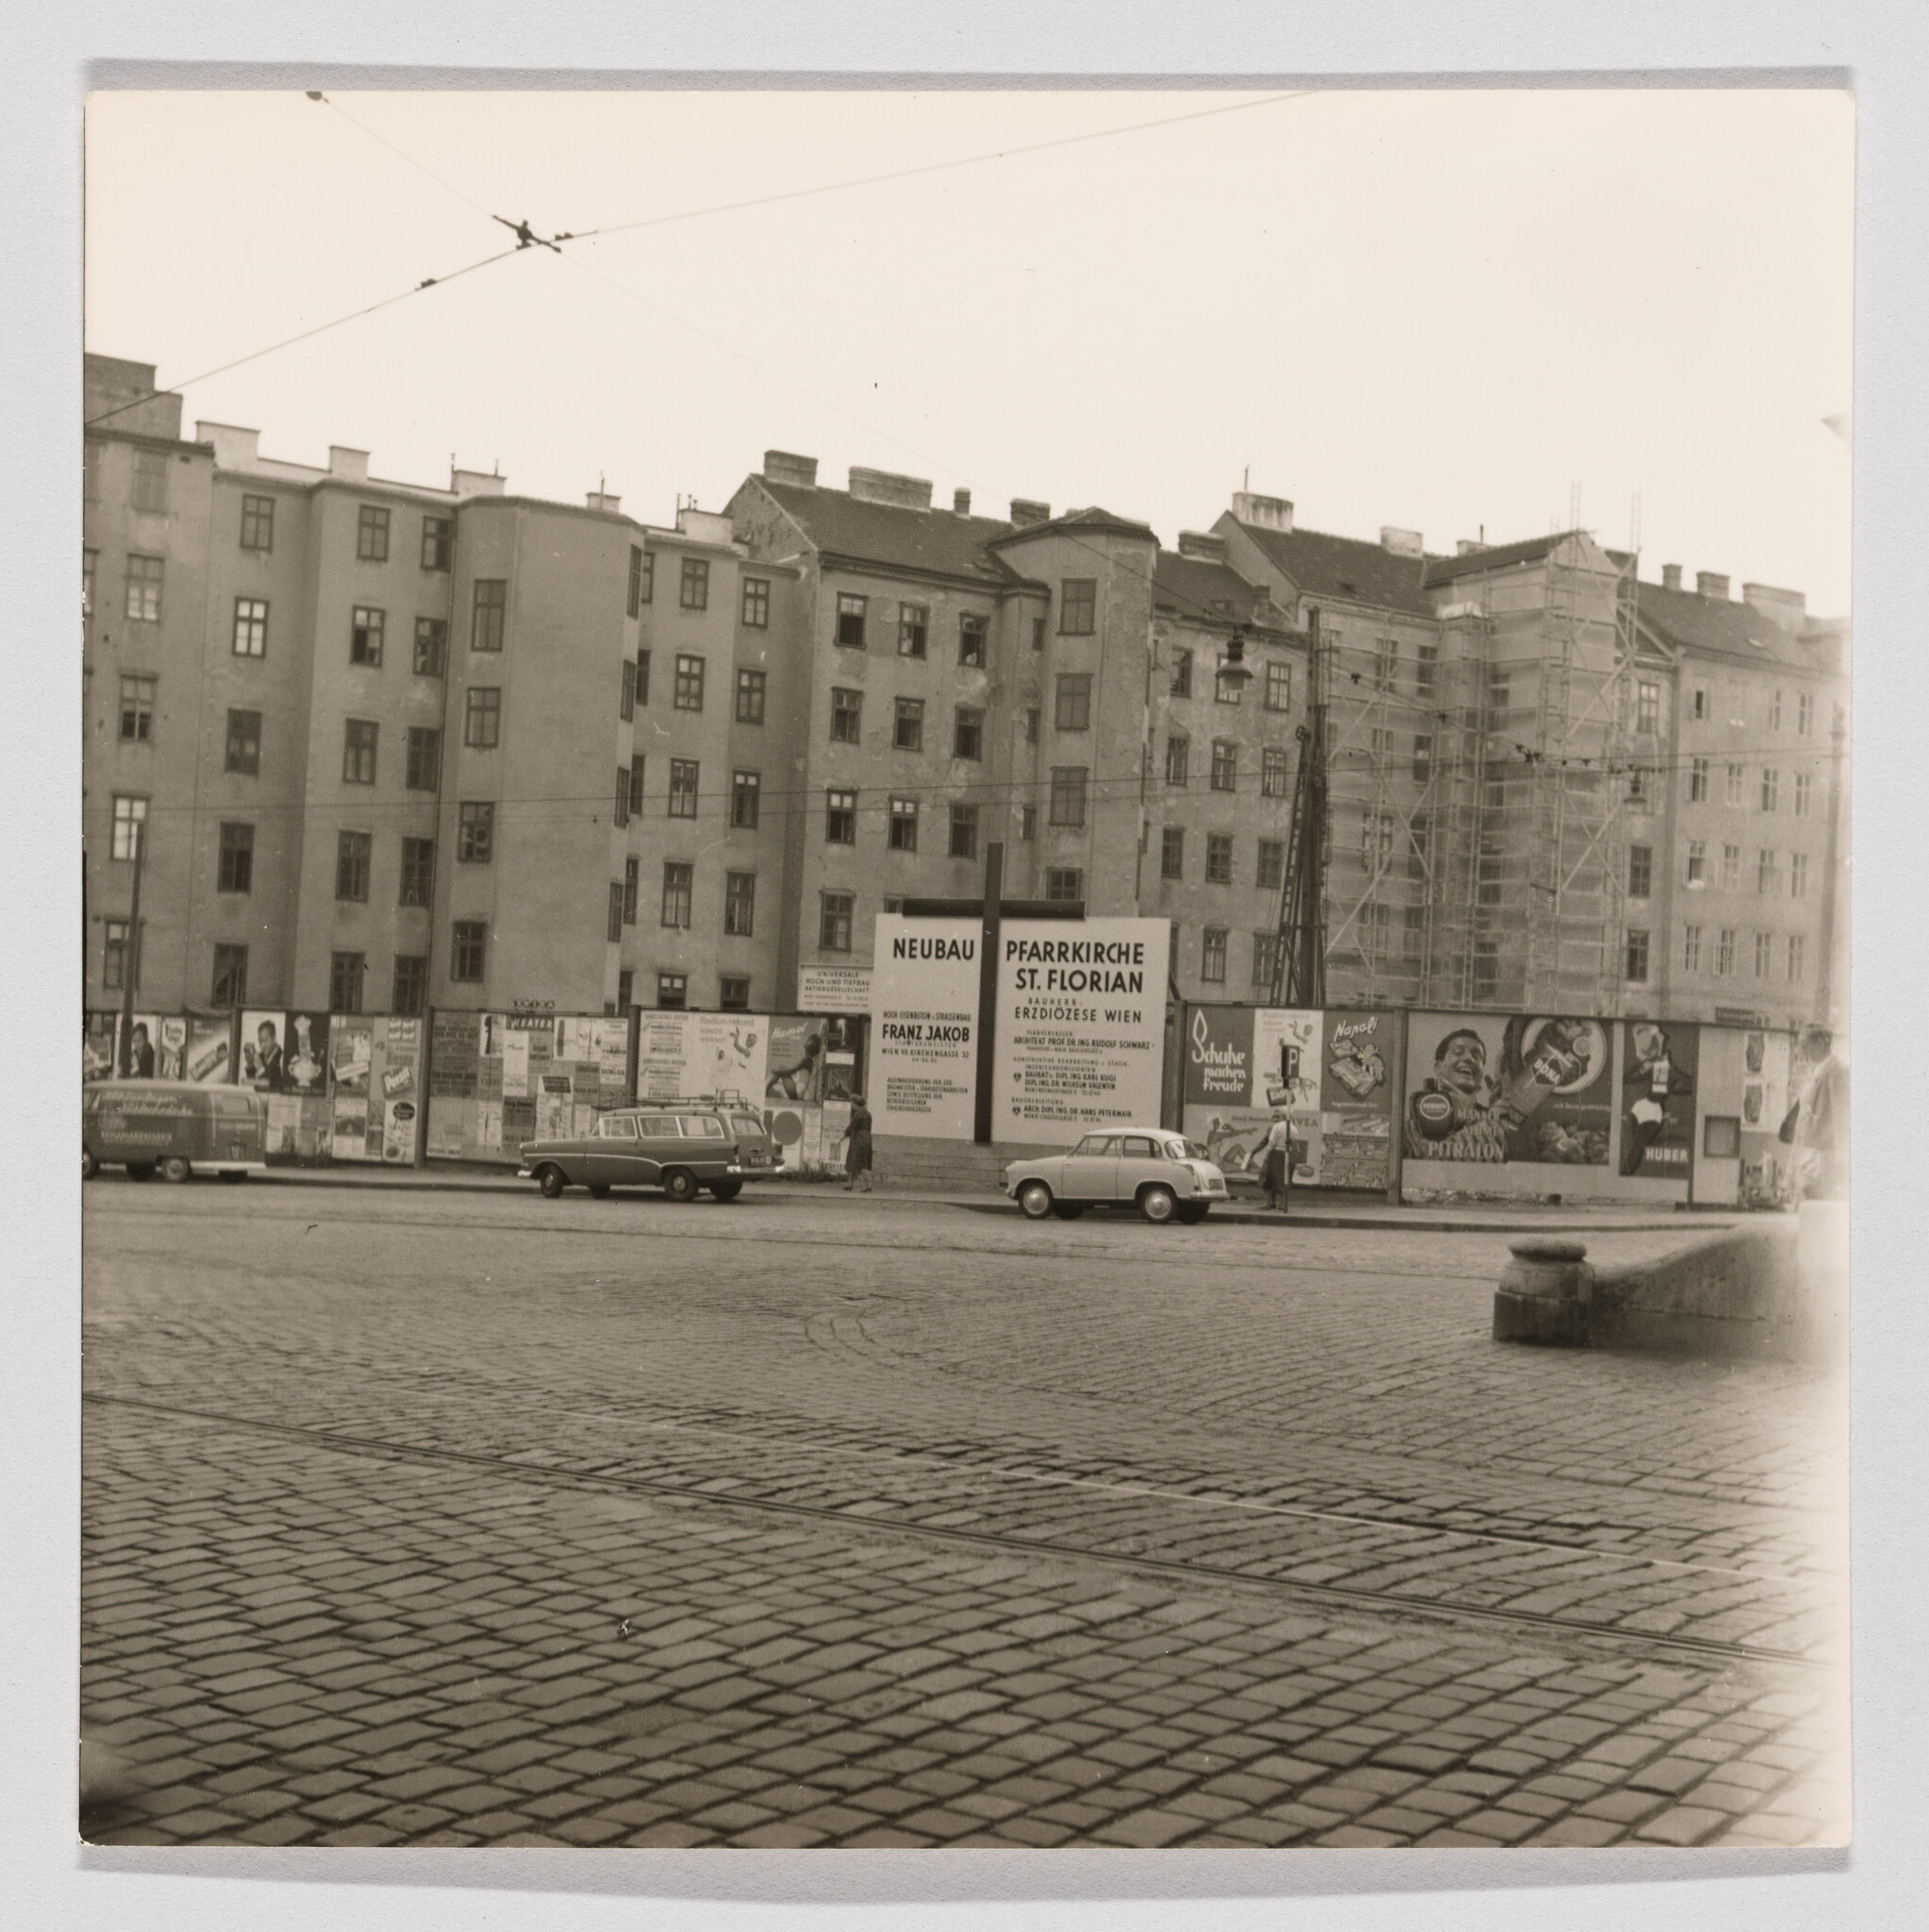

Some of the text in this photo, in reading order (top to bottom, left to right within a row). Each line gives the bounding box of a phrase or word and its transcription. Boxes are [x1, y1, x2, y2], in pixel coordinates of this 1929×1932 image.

[893, 938, 974, 960] NEUBAU
[1006, 941, 1144, 965] PFARRKIRCHE
[1015, 968, 1143, 993] ST. FLORIAN
[899, 1011, 931, 1020] EISENBETON
[935, 1012, 971, 1022] STRASSENBAU
[1015, 1006, 1141, 1023] ERZDIÖZESE WIEN
[882, 1024, 970, 1041] FRANZ JAKOB
[1333, 1016, 1379, 1042] Napoli
[1014, 1037, 1045, 1045] ARCHITEKT
[1092, 1040, 1117, 1048] RUDOLF
[1119, 1041, 1150, 1050] SCHWARZ
[910, 1049, 958, 1058] KIRCHENGASSE
[1289, 1048, 1298, 1075] P
[1204, 1065, 1247, 1079] machen
[1533, 1058, 1561, 1085] BONA
[1428, 1141, 1504, 1159] PITRALON
[1646, 1147, 1688, 1162] HUBER
